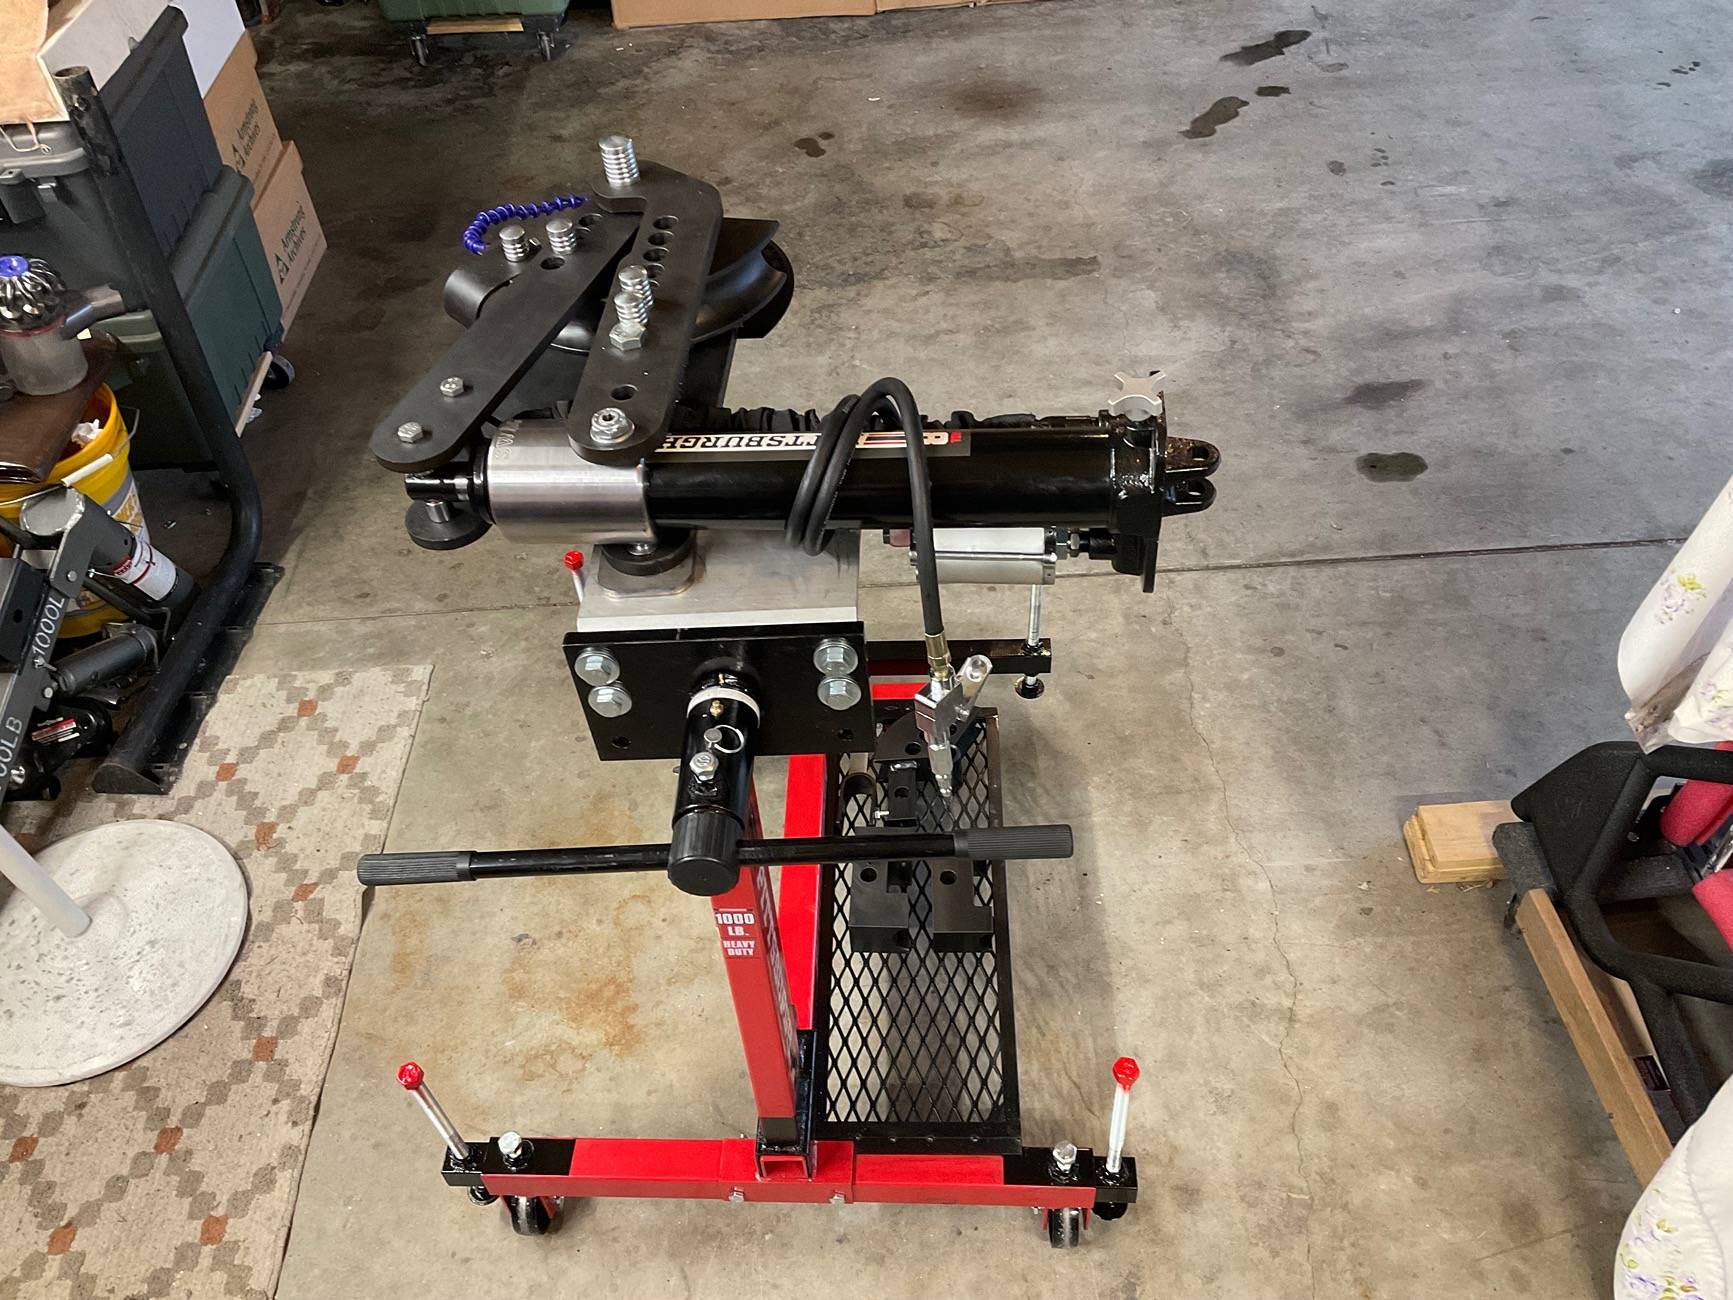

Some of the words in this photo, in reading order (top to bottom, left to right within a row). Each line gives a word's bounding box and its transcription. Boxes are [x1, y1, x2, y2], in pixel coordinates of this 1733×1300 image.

[663, 434, 862, 449] TTSBURGH
[32, 596, 65, 656] 1000L
[715, 913, 755, 924] 1000
[722, 940, 755, 948] HEAVY
[727, 948, 754, 956] DUTY
